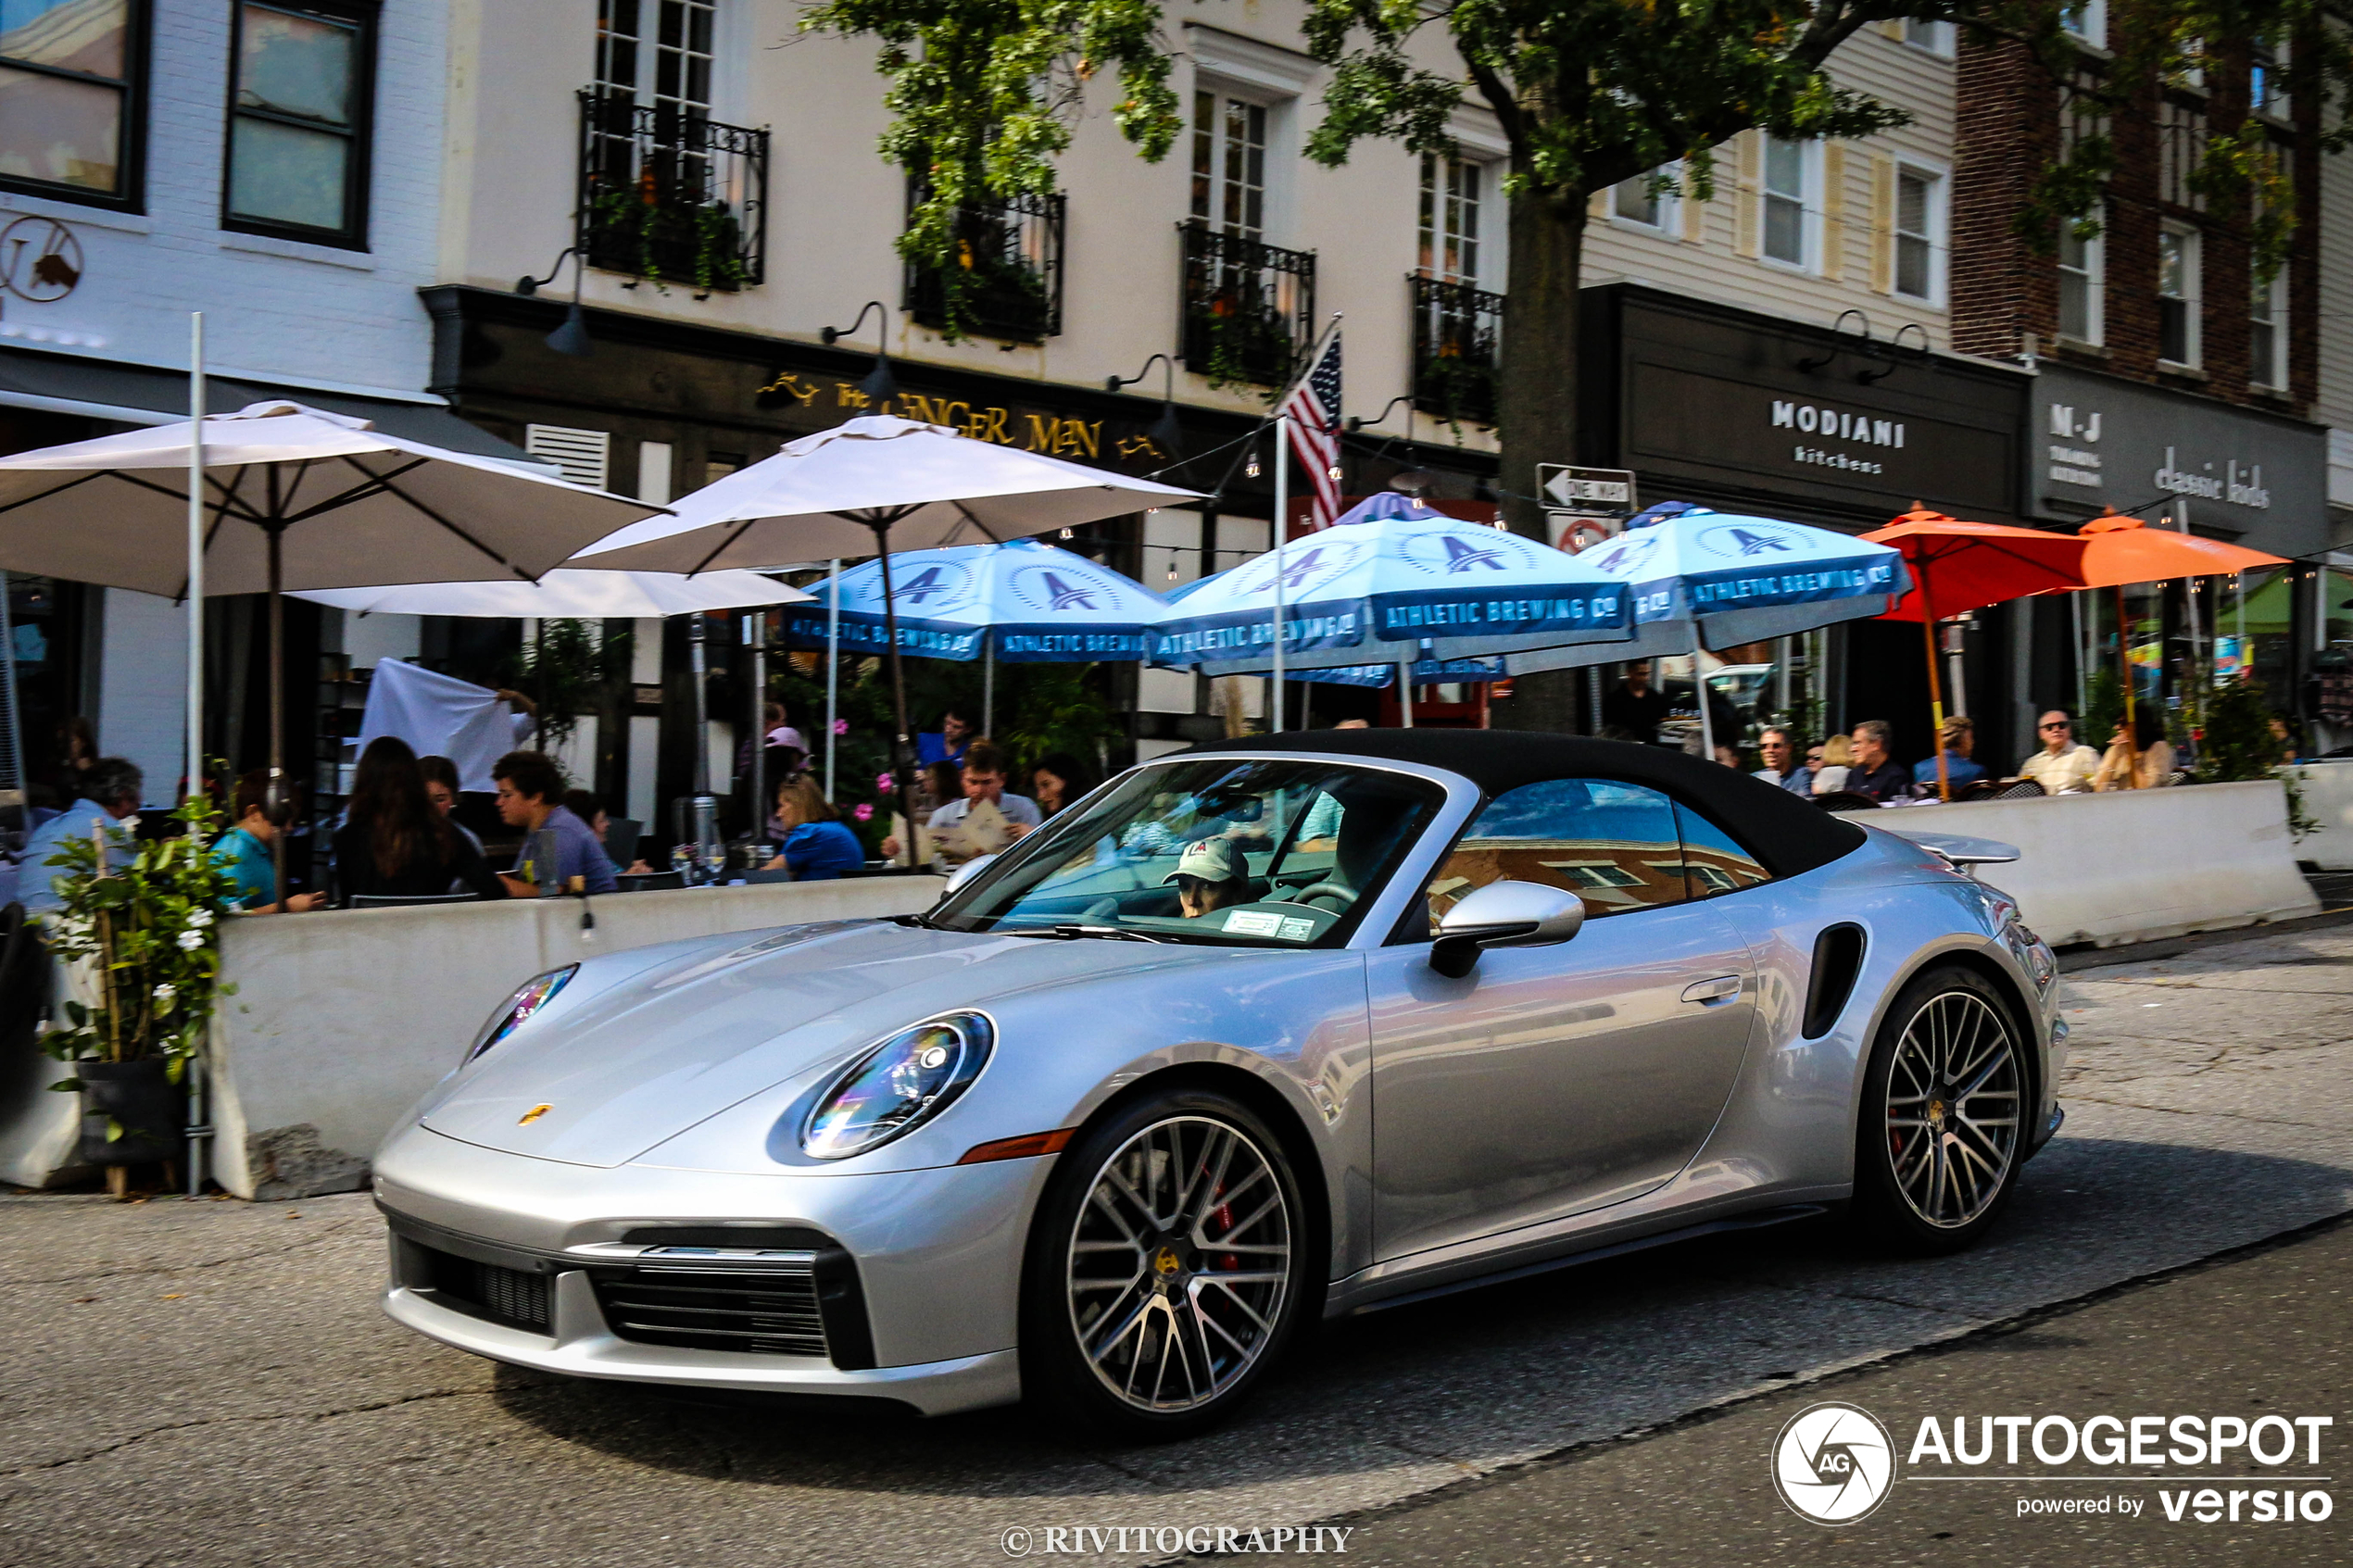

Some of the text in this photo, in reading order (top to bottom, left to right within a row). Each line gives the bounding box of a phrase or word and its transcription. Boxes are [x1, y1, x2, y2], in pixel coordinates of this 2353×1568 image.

[1771, 400, 1905, 448] MODIANI
[1794, 445, 1882, 474] kitchens
[1566, 480, 1629, 500] ONE WAY
[1694, 577, 1780, 602] ATHLETIC
[1780, 568, 1866, 594] BREWING
[1387, 602, 1481, 628] ATHLETIC
[1487, 598, 1584, 622] BREWING
[1157, 625, 1248, 655] ATHLETIC
